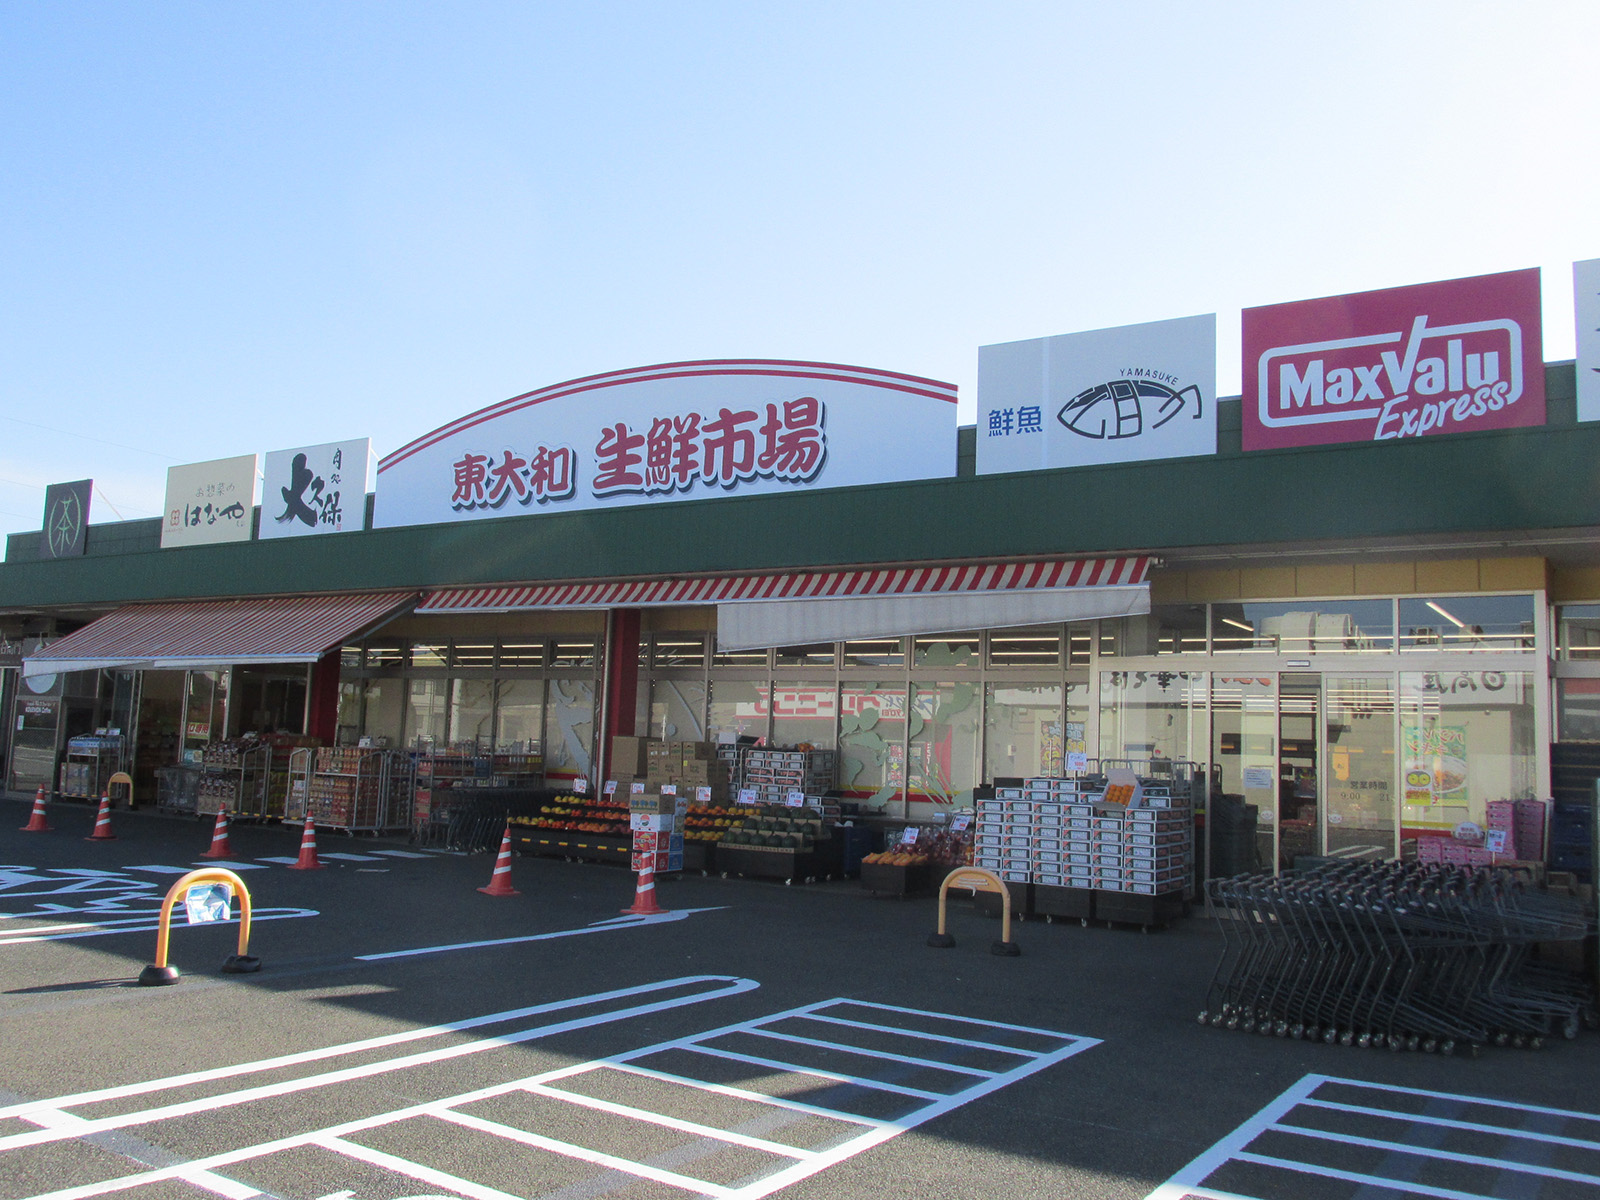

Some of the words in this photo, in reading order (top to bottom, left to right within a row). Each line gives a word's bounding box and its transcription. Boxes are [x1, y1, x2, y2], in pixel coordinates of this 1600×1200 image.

[1119, 368, 1179, 386] YAMASUKE
[1280, 315, 1499, 409] MaxValu
[988, 405, 1043, 437] 鮮魚
[1374, 381, 1509, 440] Express
[451, 447, 574, 506] 東大和
[592, 396, 824, 494] 生鮮市場
[274, 453, 342, 527] 大久保
[184, 501, 245, 527] はなや
[1340, 791, 1361, 800] 9:00
[1350, 781, 1387, 790] 営業時間
